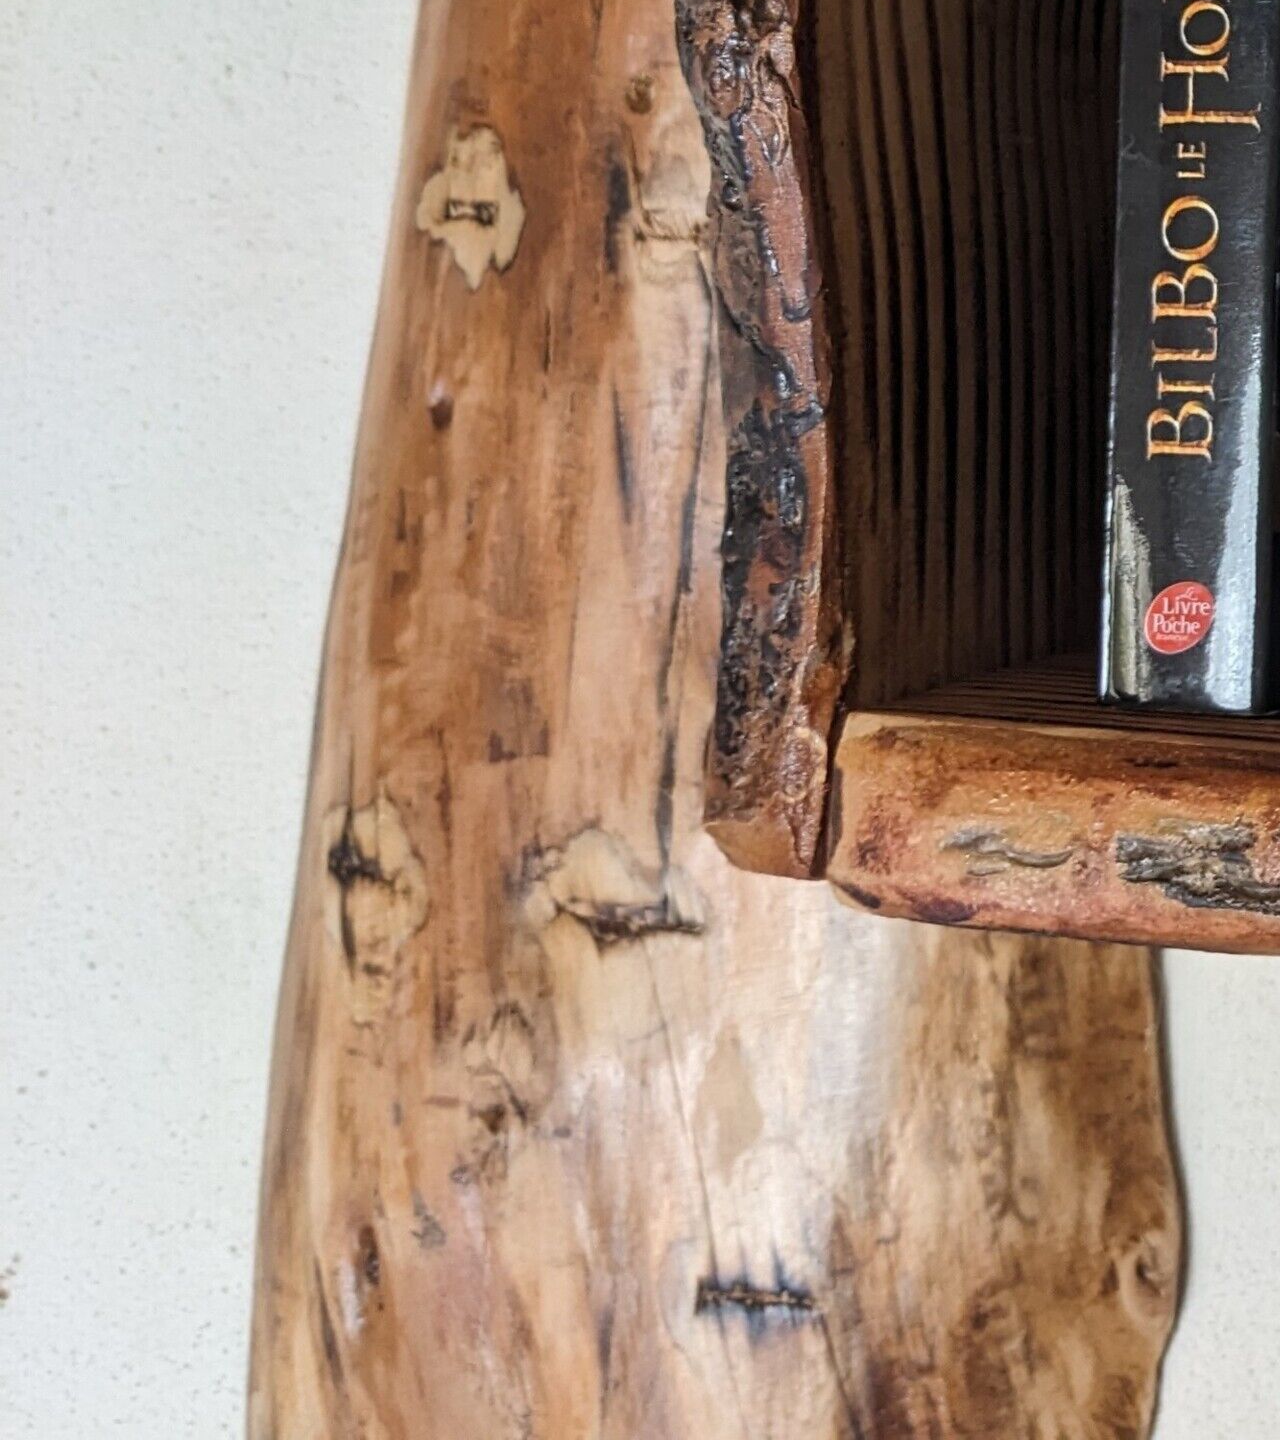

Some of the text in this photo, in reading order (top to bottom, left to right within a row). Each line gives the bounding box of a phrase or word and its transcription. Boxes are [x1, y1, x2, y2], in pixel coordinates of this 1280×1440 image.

[1176, 141, 1207, 179] LE
[1146, 194, 1220, 463] BILBO
[1162, 596, 1211, 616] Livre
[1153, 614, 1201, 635] Poche
